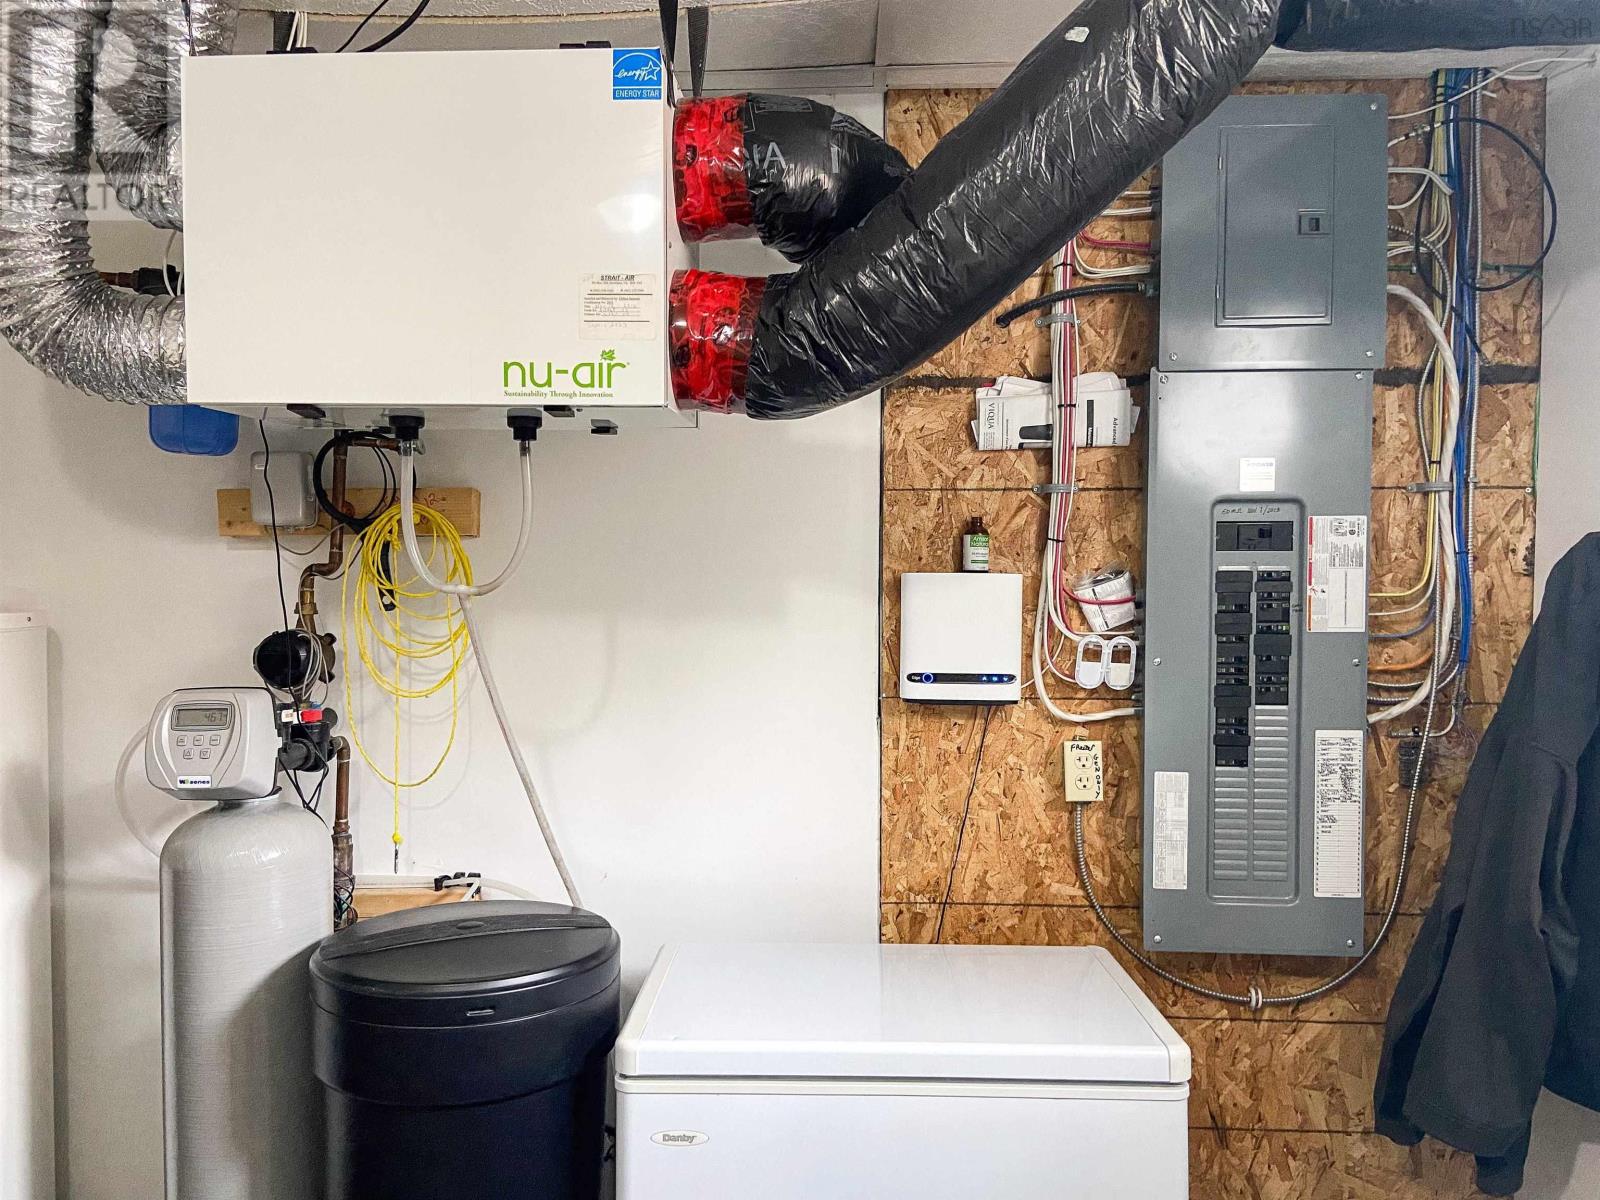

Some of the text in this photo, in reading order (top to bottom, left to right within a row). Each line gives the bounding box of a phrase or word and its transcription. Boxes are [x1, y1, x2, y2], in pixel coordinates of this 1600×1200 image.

[615, 89, 660, 98] ENERGY STAR
[503, 358, 628, 389] nu-air
[503, 390, 613, 399] Sustainability Through Innovation
[987, 403, 996, 429] VIQUA
[662, 1133, 697, 1144] Danby
